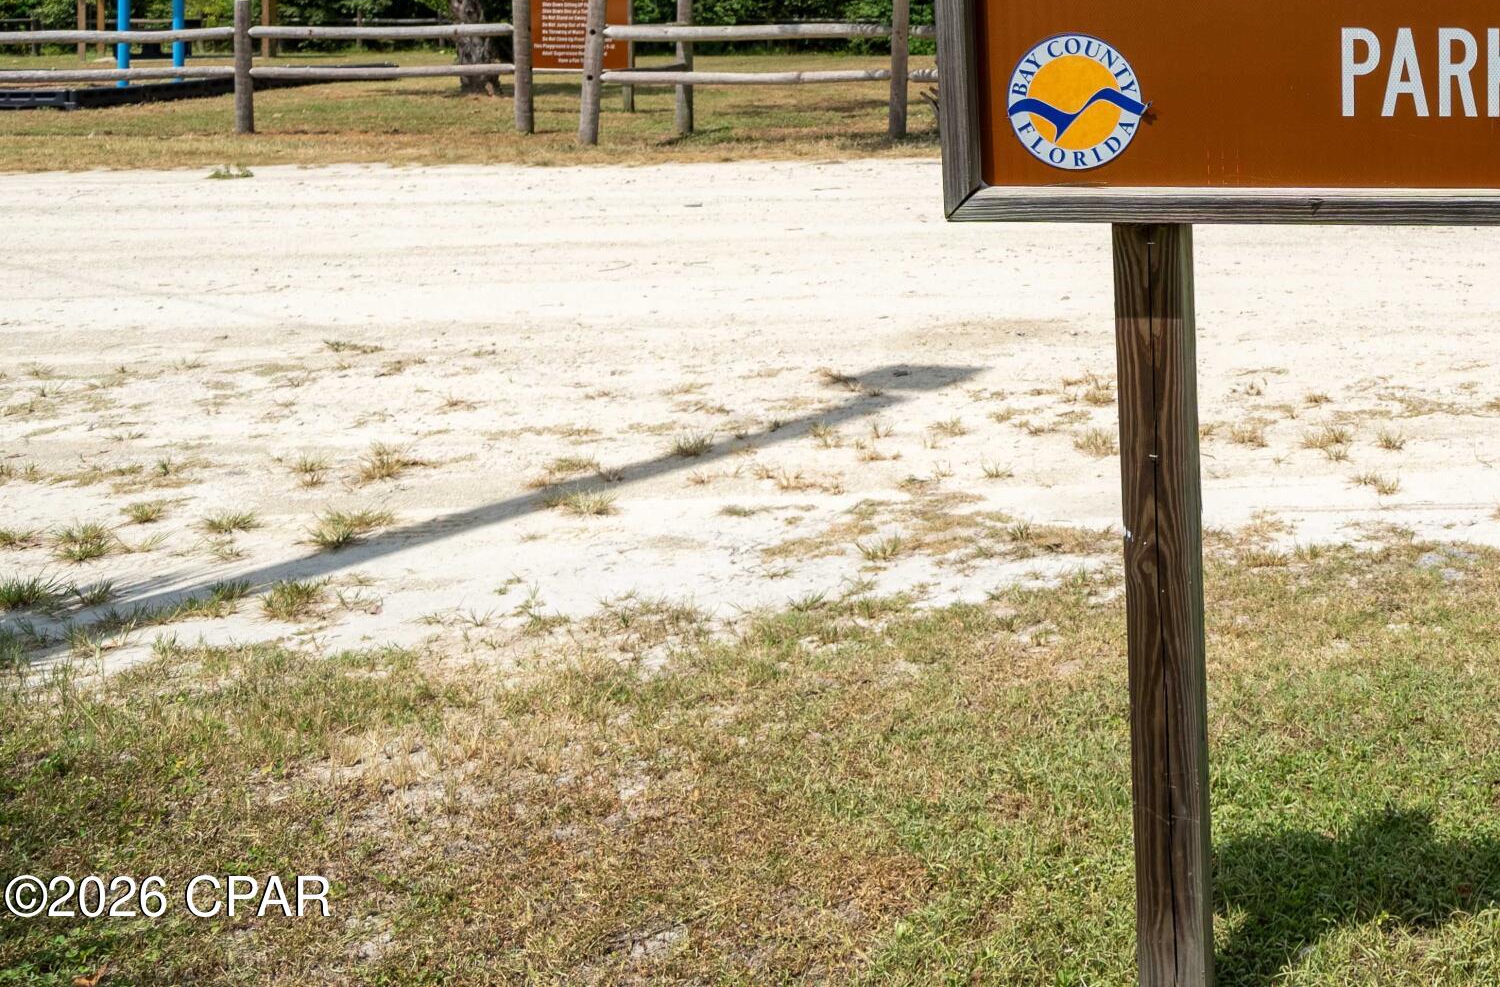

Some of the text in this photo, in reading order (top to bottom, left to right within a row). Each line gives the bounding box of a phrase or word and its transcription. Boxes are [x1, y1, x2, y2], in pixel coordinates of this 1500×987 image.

[1011, 37, 1138, 97] BAY COUNTY
[1017, 120, 1136, 167] FLORIDA
